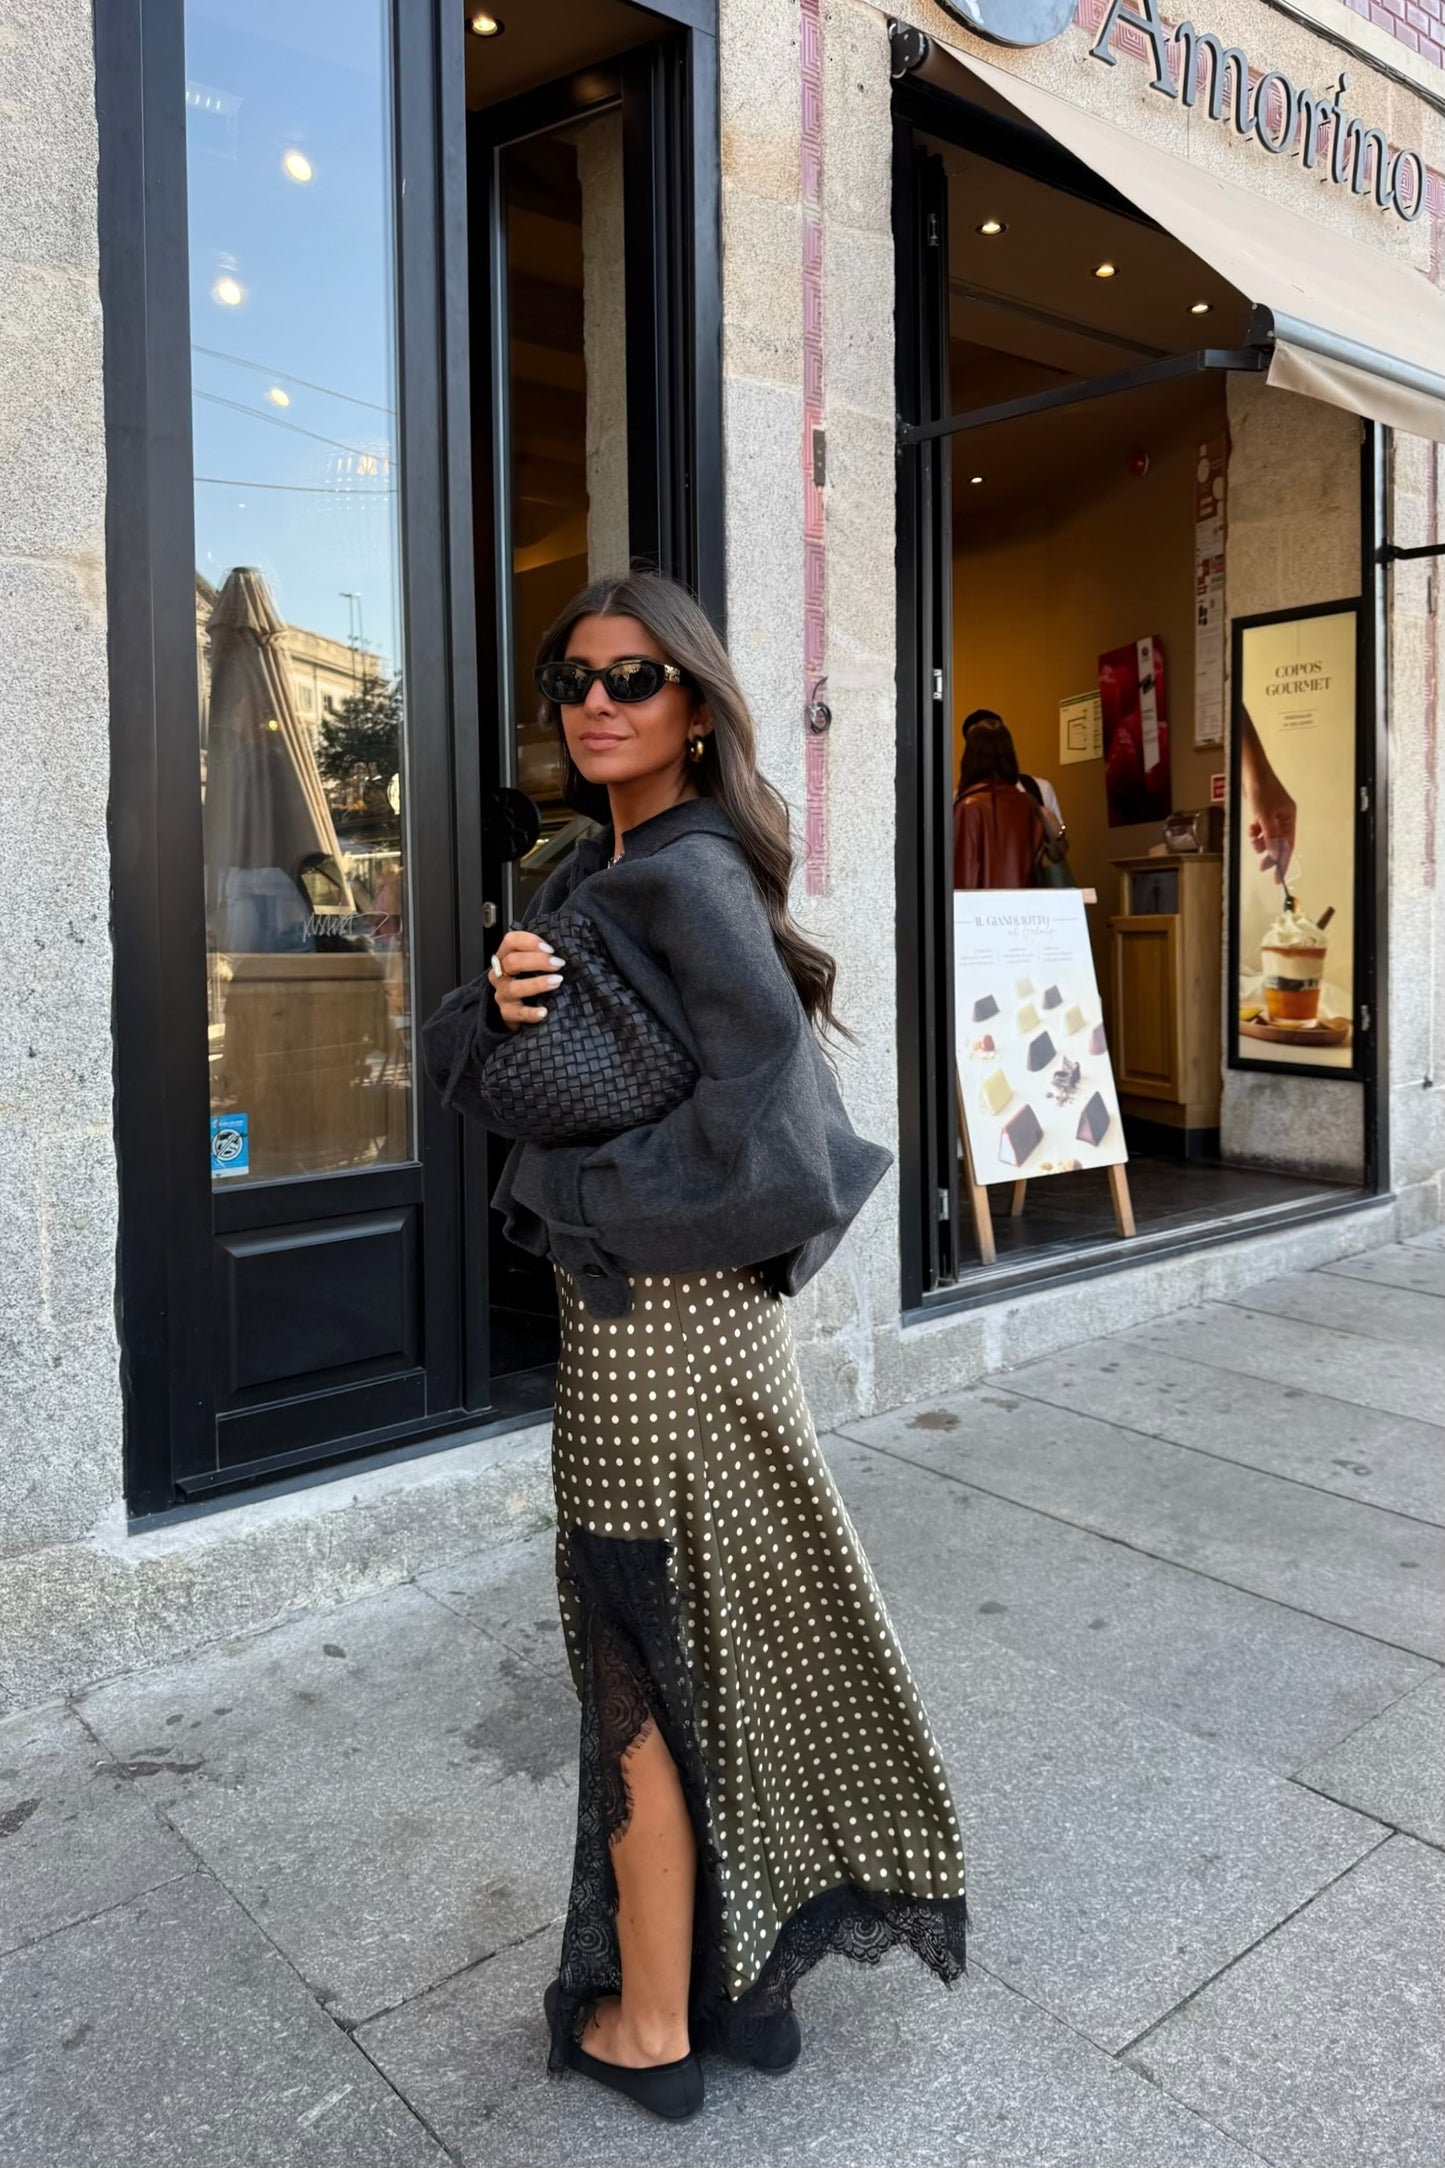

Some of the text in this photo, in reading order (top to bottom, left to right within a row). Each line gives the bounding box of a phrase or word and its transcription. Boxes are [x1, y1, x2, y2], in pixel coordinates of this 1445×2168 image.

[1089, 0, 1427, 221] Amorino
[1275, 660, 1322, 678] COPOS
[1265, 676, 1332, 696] GOURMET
